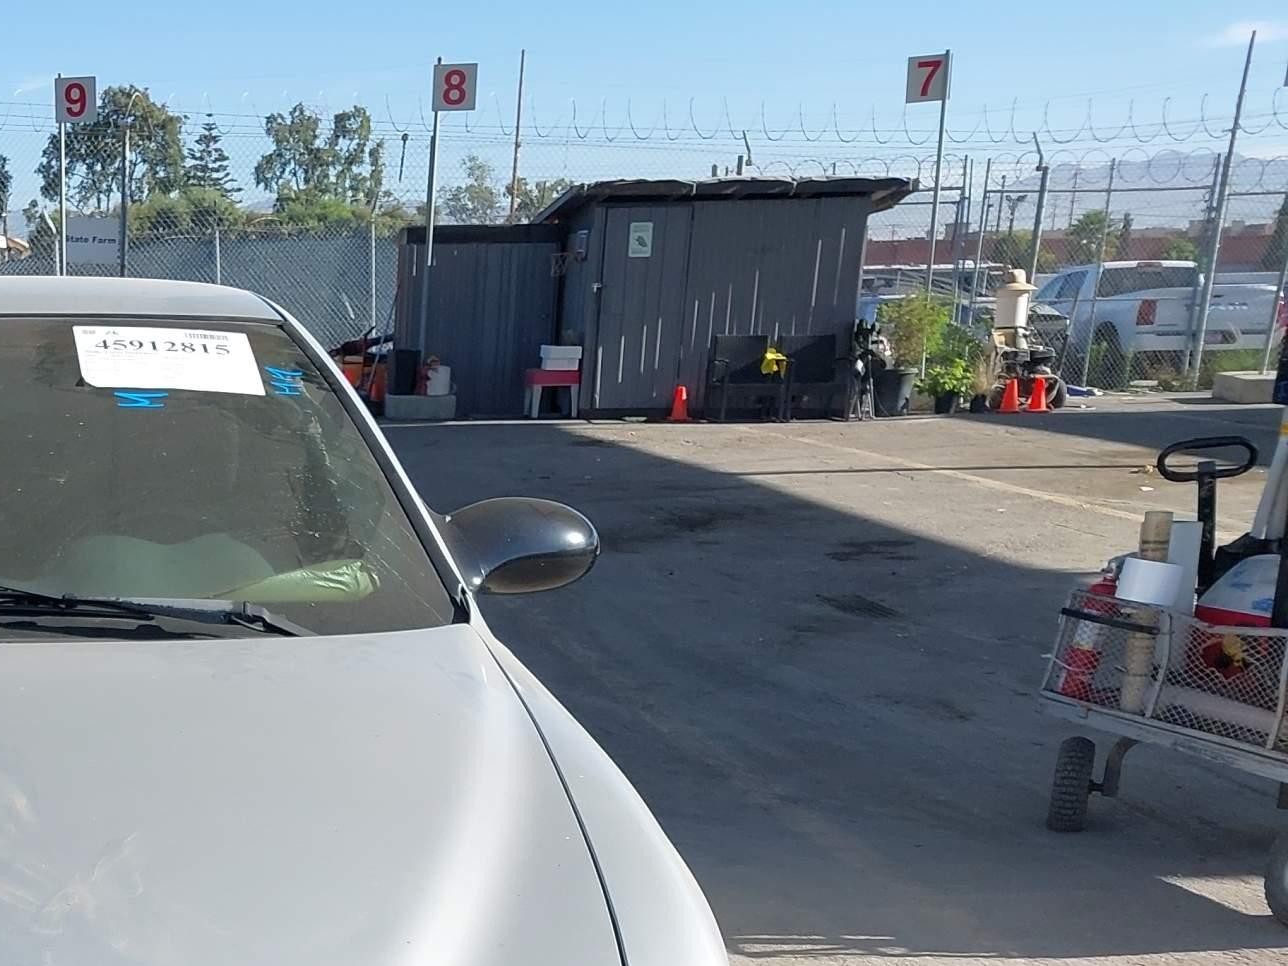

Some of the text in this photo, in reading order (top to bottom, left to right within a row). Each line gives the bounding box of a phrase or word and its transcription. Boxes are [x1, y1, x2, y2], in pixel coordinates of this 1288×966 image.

[443, 69, 466, 106] 8
[918, 60, 943, 97] 7
[64, 82, 87, 118] 9
[92, 235, 117, 245] Farm
[95, 338, 231, 356] 45912815
